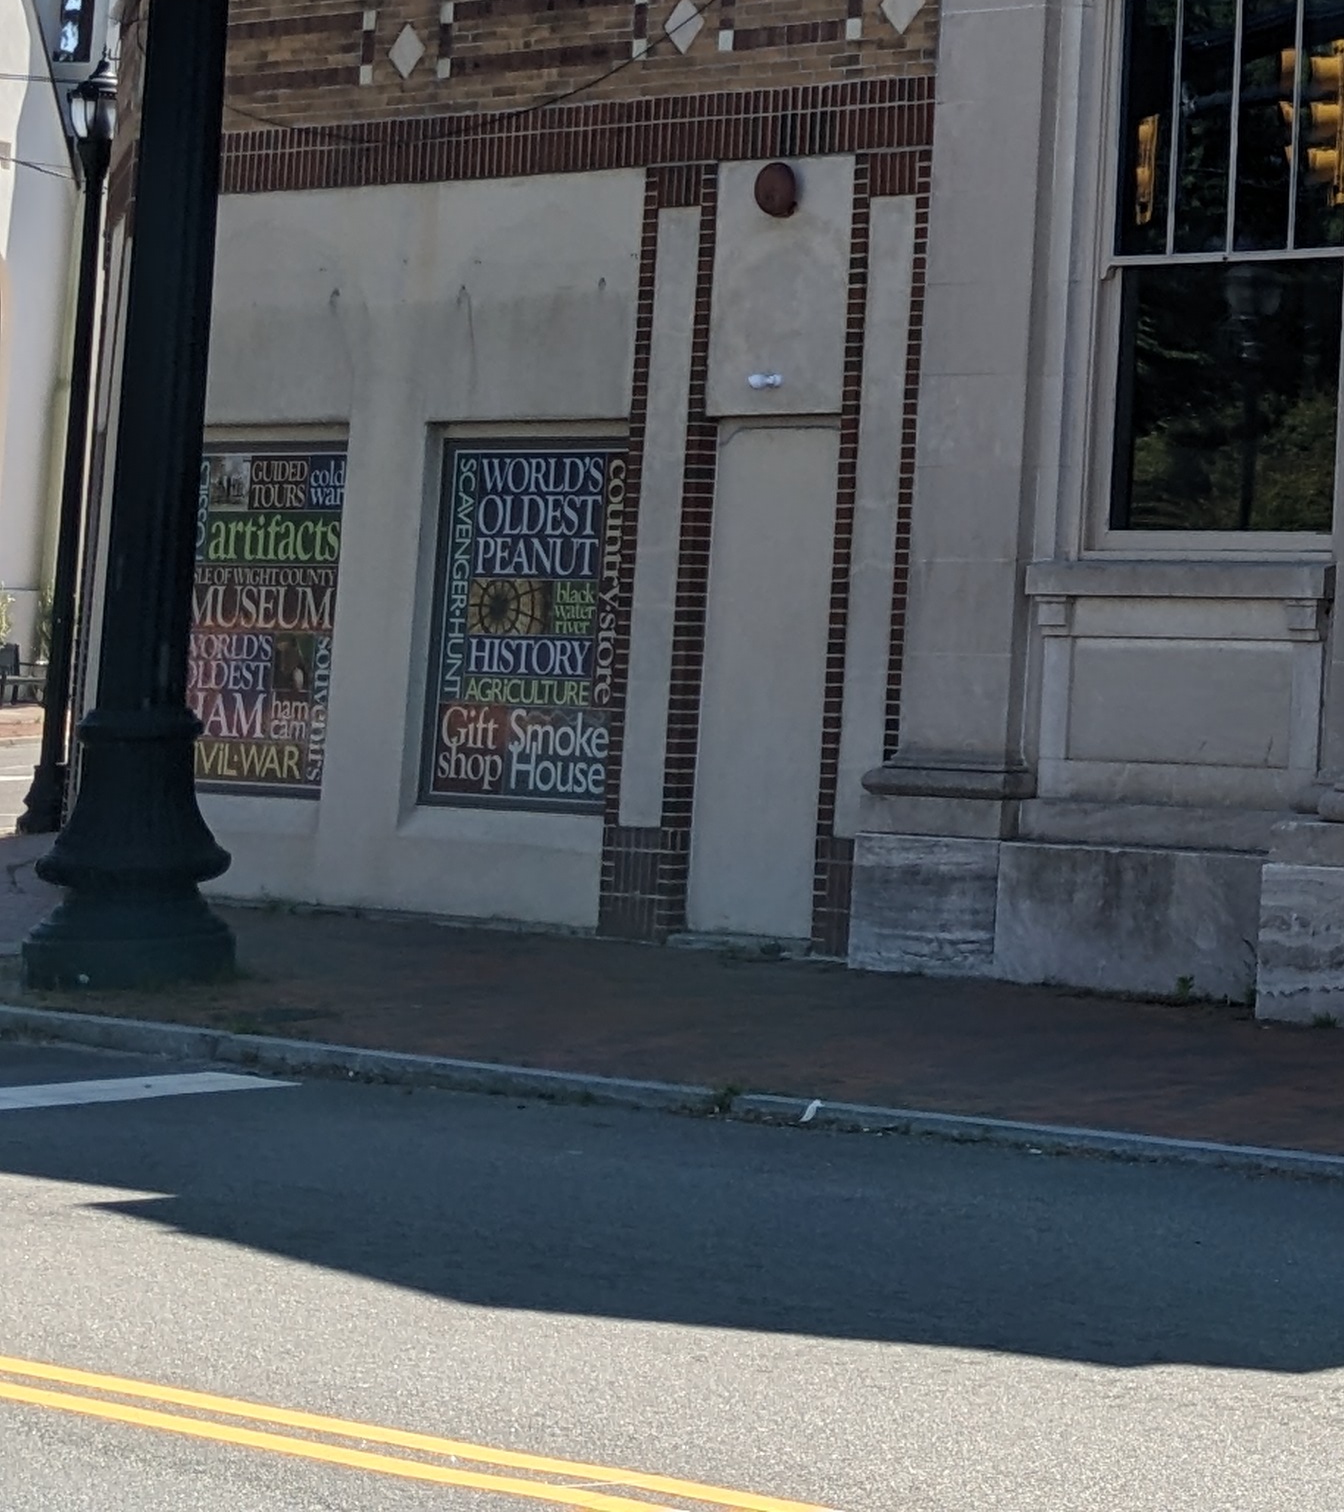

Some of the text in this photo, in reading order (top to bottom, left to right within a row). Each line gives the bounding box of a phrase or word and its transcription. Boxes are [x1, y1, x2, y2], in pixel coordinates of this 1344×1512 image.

[252, 460, 308, 482] GUIDED
[311, 460, 345, 487] cold
[482, 456, 604, 493] WORLD'S
[253, 484, 307, 508] TOURS
[478, 494, 602, 536] OLDEST
[208, 513, 341, 562] artifacts
[475, 537, 599, 576] PEANUT
[214, 567, 232, 585] OF
[233, 567, 280, 586] WIGHT
[280, 568, 337, 587] COUNTY
[556, 581, 595, 603] black
[554, 604, 597, 620] water
[555, 620, 590, 634] river
[468, 637, 592, 676] HISTORY
[271, 692, 309, 719] ham
[306, 636, 332, 782] souvenirs
[270, 719, 306, 739] cam
[442, 706, 499, 750] Gift
[508, 708, 609, 759] Smoke
[438, 737, 503, 790] shop
[509, 740, 606, 795] House
